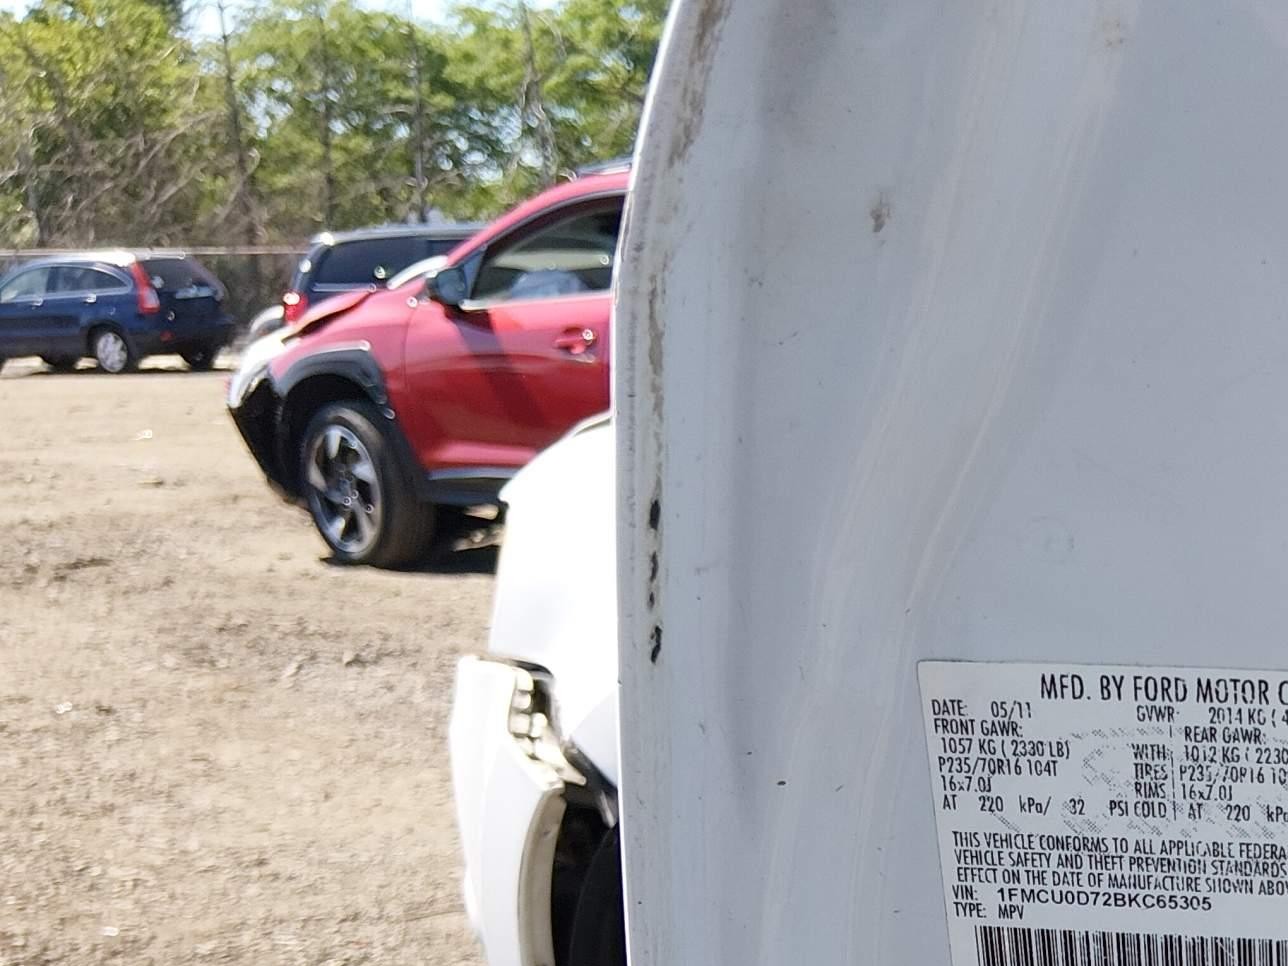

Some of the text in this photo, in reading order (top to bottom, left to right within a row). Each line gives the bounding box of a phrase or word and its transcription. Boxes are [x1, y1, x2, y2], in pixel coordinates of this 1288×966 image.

[1040, 673, 1091, 700] MFD.
[1100, 675, 1124, 701] BY
[1133, 676, 1187, 702] FORD
[1196, 678, 1269, 705] MOTOR
[932, 699, 1031, 720] DATE: 05/11
[1209, 707, 1242, 724] 2014
[1248, 709, 1266, 725] KG
[934, 719, 1023, 737] FRONT GAWR:
[1185, 726, 1266, 744] REAR GAWR:
[941, 738, 972, 754] 1057
[979, 739, 996, 755] KG
[1012, 741, 1044, 757] 2330
[1050, 742, 1069, 759] LB)
[1185, 745, 1216, 763] 1012
[1222, 746, 1240, 763] KG
[939, 757, 1057, 777] P235/70R16 104T
[1134, 782, 1166, 798] RIMS
[943, 795, 957, 810] AT
[979, 796, 1003, 812] 220
[1069, 799, 1085, 815] 32
[1109, 800, 1128, 817] PSI
[1134, 801, 1166, 818] COLD
[1188, 804, 1203, 820] AT
[1226, 804, 1250, 821] 220
[952, 831, 980, 848] THIS
[984, 833, 1034, 850] VEHICLE
[1039, 835, 1108, 853] CONFORMS
[1112, 838, 1128, 853] TO
[1134, 839, 1155, 855] ALL
[954, 850, 1005, 866] VEHICLE
[1009, 852, 1051, 868] SAFETY
[1057, 855, 1083, 870] AND
[1088, 855, 1124, 871] THEFT
[1129, 858, 1207, 875] PREVENTION
[1211, 860, 1287, 878] STANDARDS
[957, 868, 998, 884] EFFECT
[1003, 870, 1020, 885] ON
[1024, 870, 1048, 886] THE
[1052, 871, 1083, 887] DATE
[1088, 873, 1104, 887] OF
[1108, 874, 1202, 893] MANUFACTURE
[952, 886, 1212, 911] VIN: 1FMCU0D72BKC65305
[953, 903, 1023, 920] TYPE: MPV
